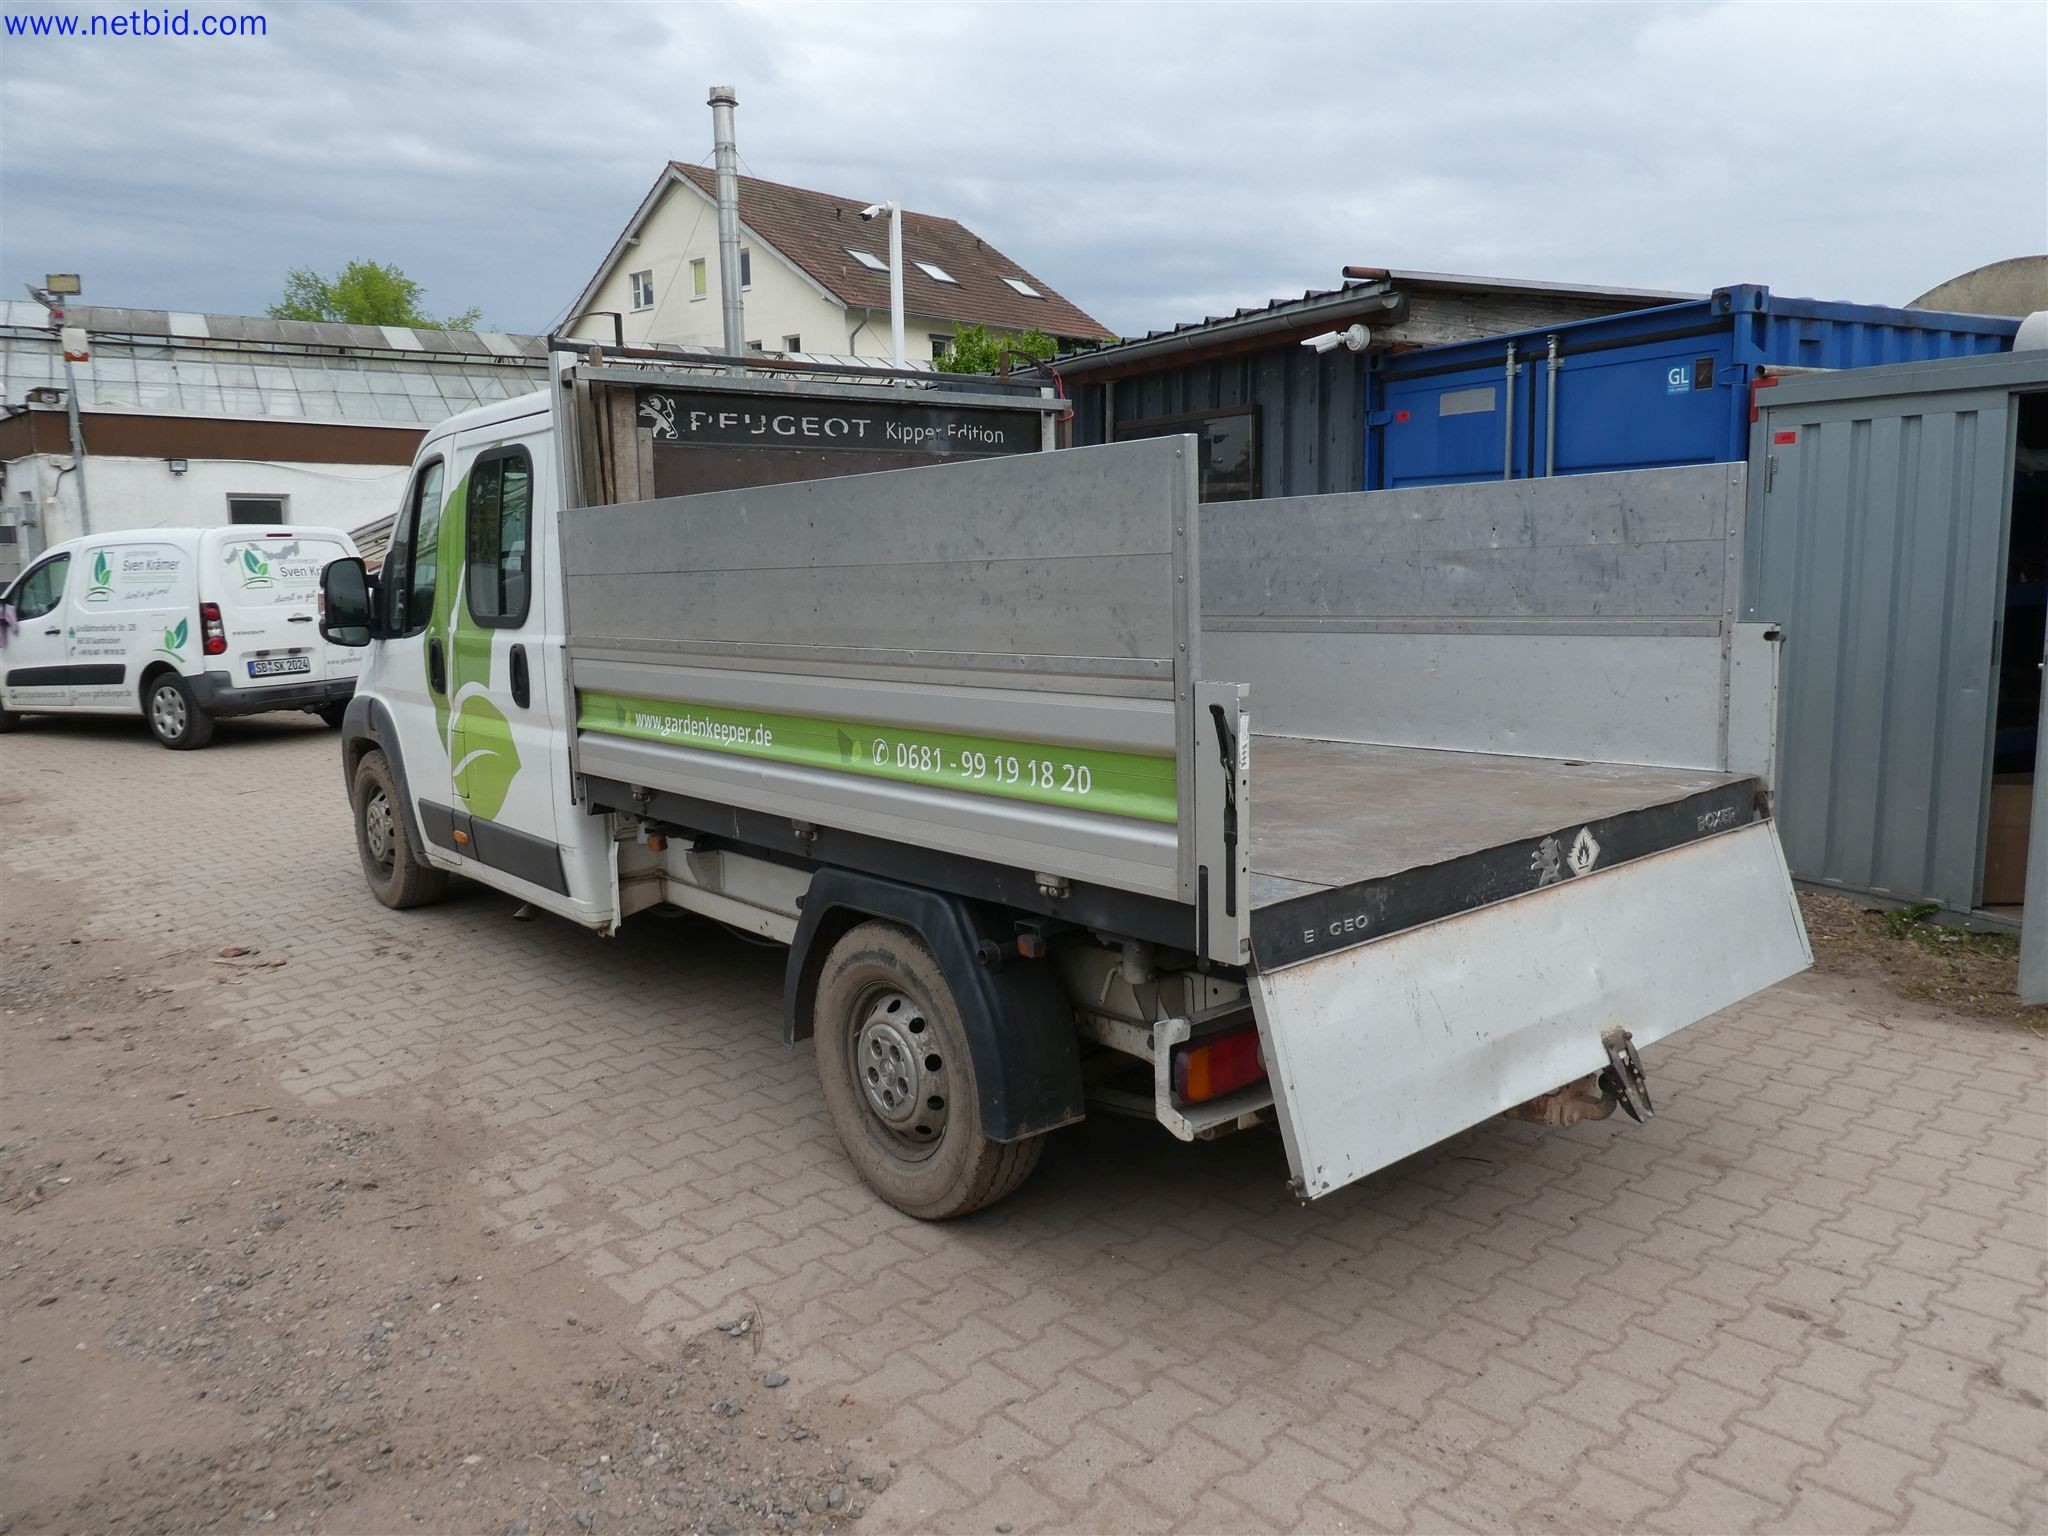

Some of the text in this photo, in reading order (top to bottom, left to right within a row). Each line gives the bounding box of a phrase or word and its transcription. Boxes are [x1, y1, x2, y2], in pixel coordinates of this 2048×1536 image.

[1668, 367, 1689, 385] GL
[280, 565, 307, 578] Sven
[256, 659, 309, 674] SB SK 2024
[635, 713, 773, 746] www.gardenkeeper.de
[896, 743, 941, 773] 0681
[961, 751, 986, 779] 99
[994, 755, 1020, 784] 19
[1028, 759, 1054, 789] 18
[1060, 764, 1092, 794] 20
